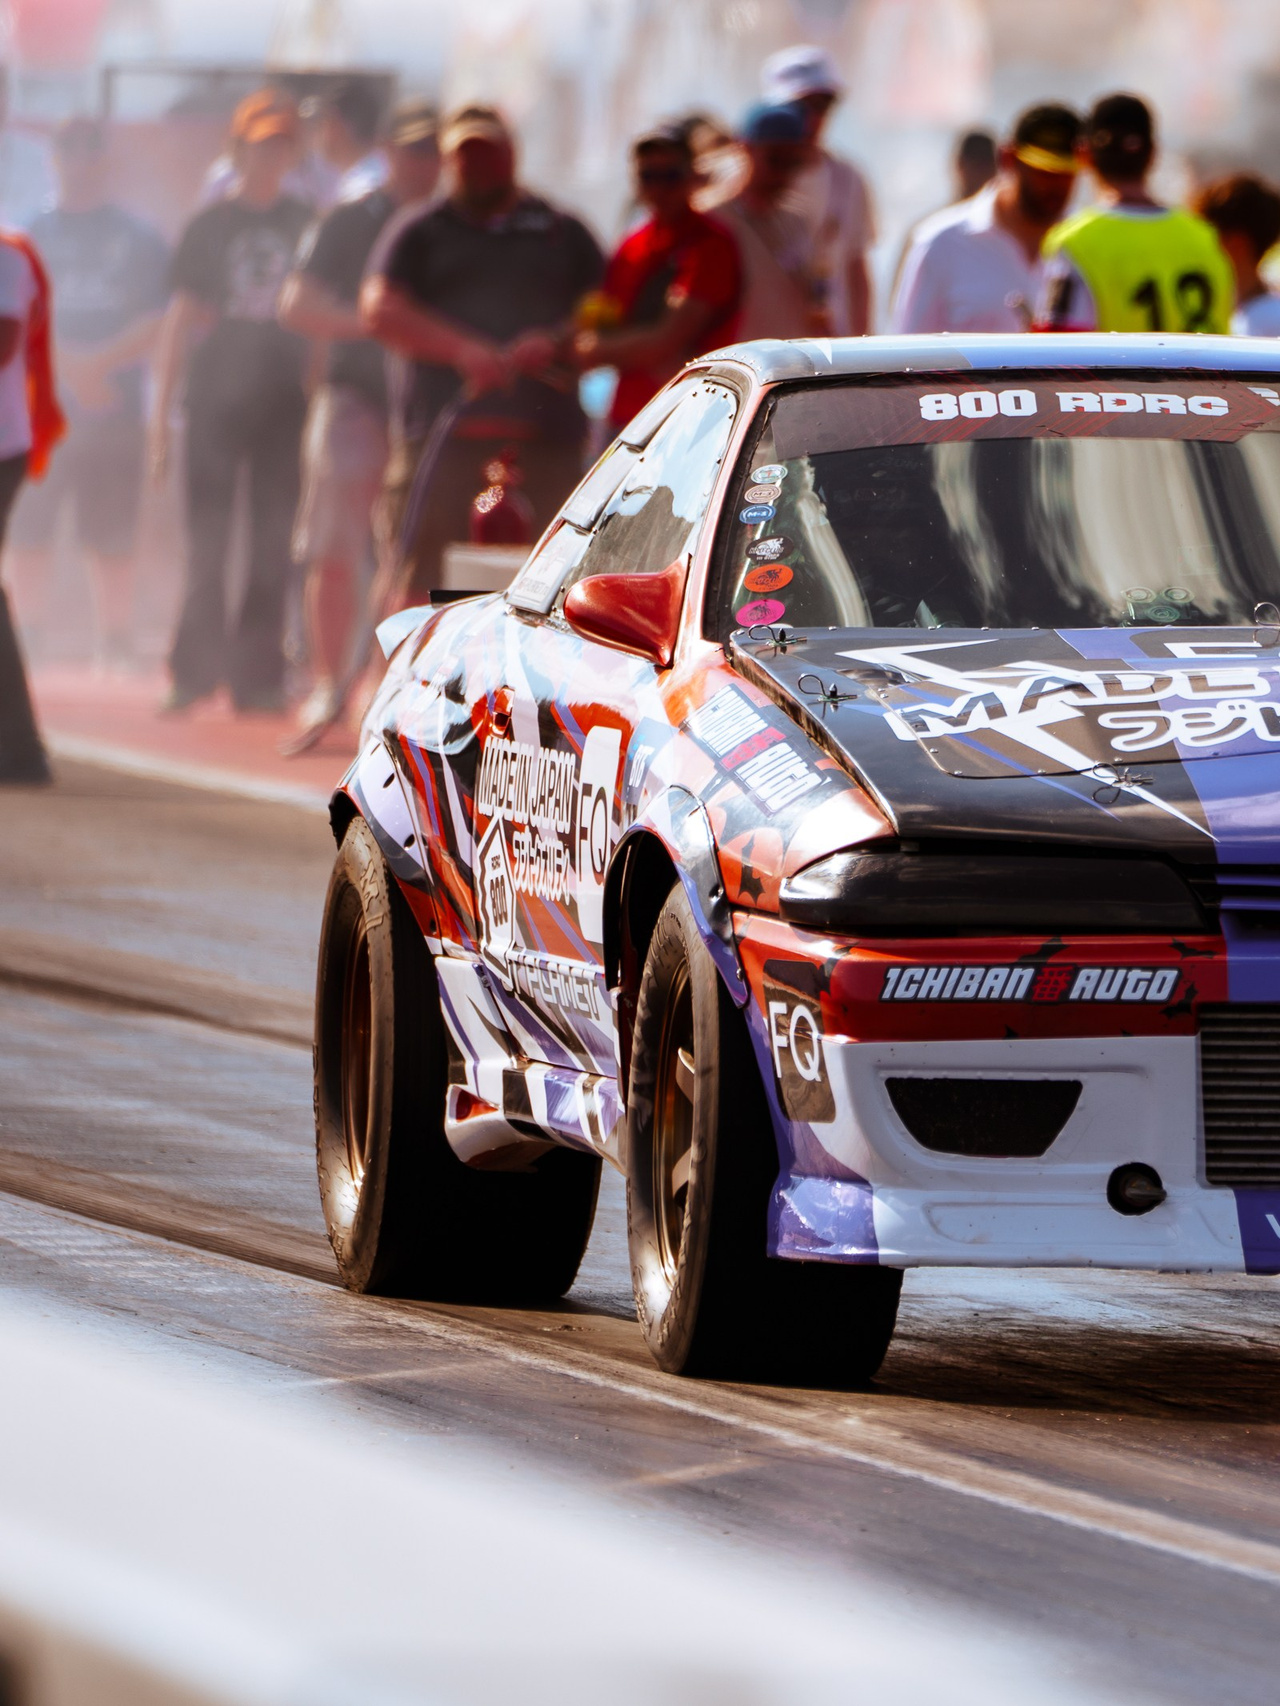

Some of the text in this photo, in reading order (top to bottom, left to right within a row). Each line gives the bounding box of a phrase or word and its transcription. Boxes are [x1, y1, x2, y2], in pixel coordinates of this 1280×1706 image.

[919, 389, 1038, 421] 800
[529, 747, 576, 834] JAPAN
[579, 783, 608, 886] FQ
[489, 875, 509, 927] 800
[881, 968, 1034, 999] ICHIBAN
[1069, 969, 1177, 1000] AUTO
[768, 1000, 822, 1083] FQ
